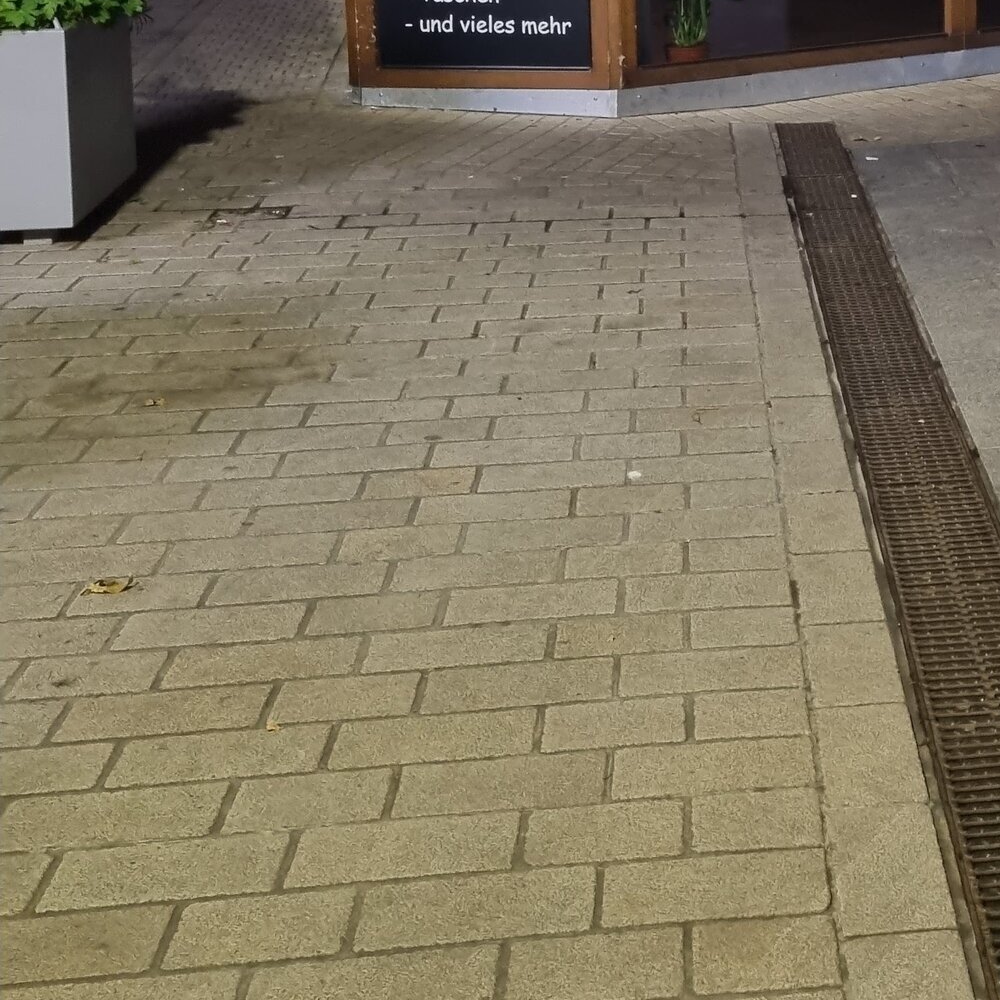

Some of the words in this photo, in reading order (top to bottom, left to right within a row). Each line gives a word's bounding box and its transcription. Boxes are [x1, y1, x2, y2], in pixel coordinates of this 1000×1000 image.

[419, 14, 454, 33] und
[460, 14, 515, 34] vieles
[521, 15, 572, 35] mehr
